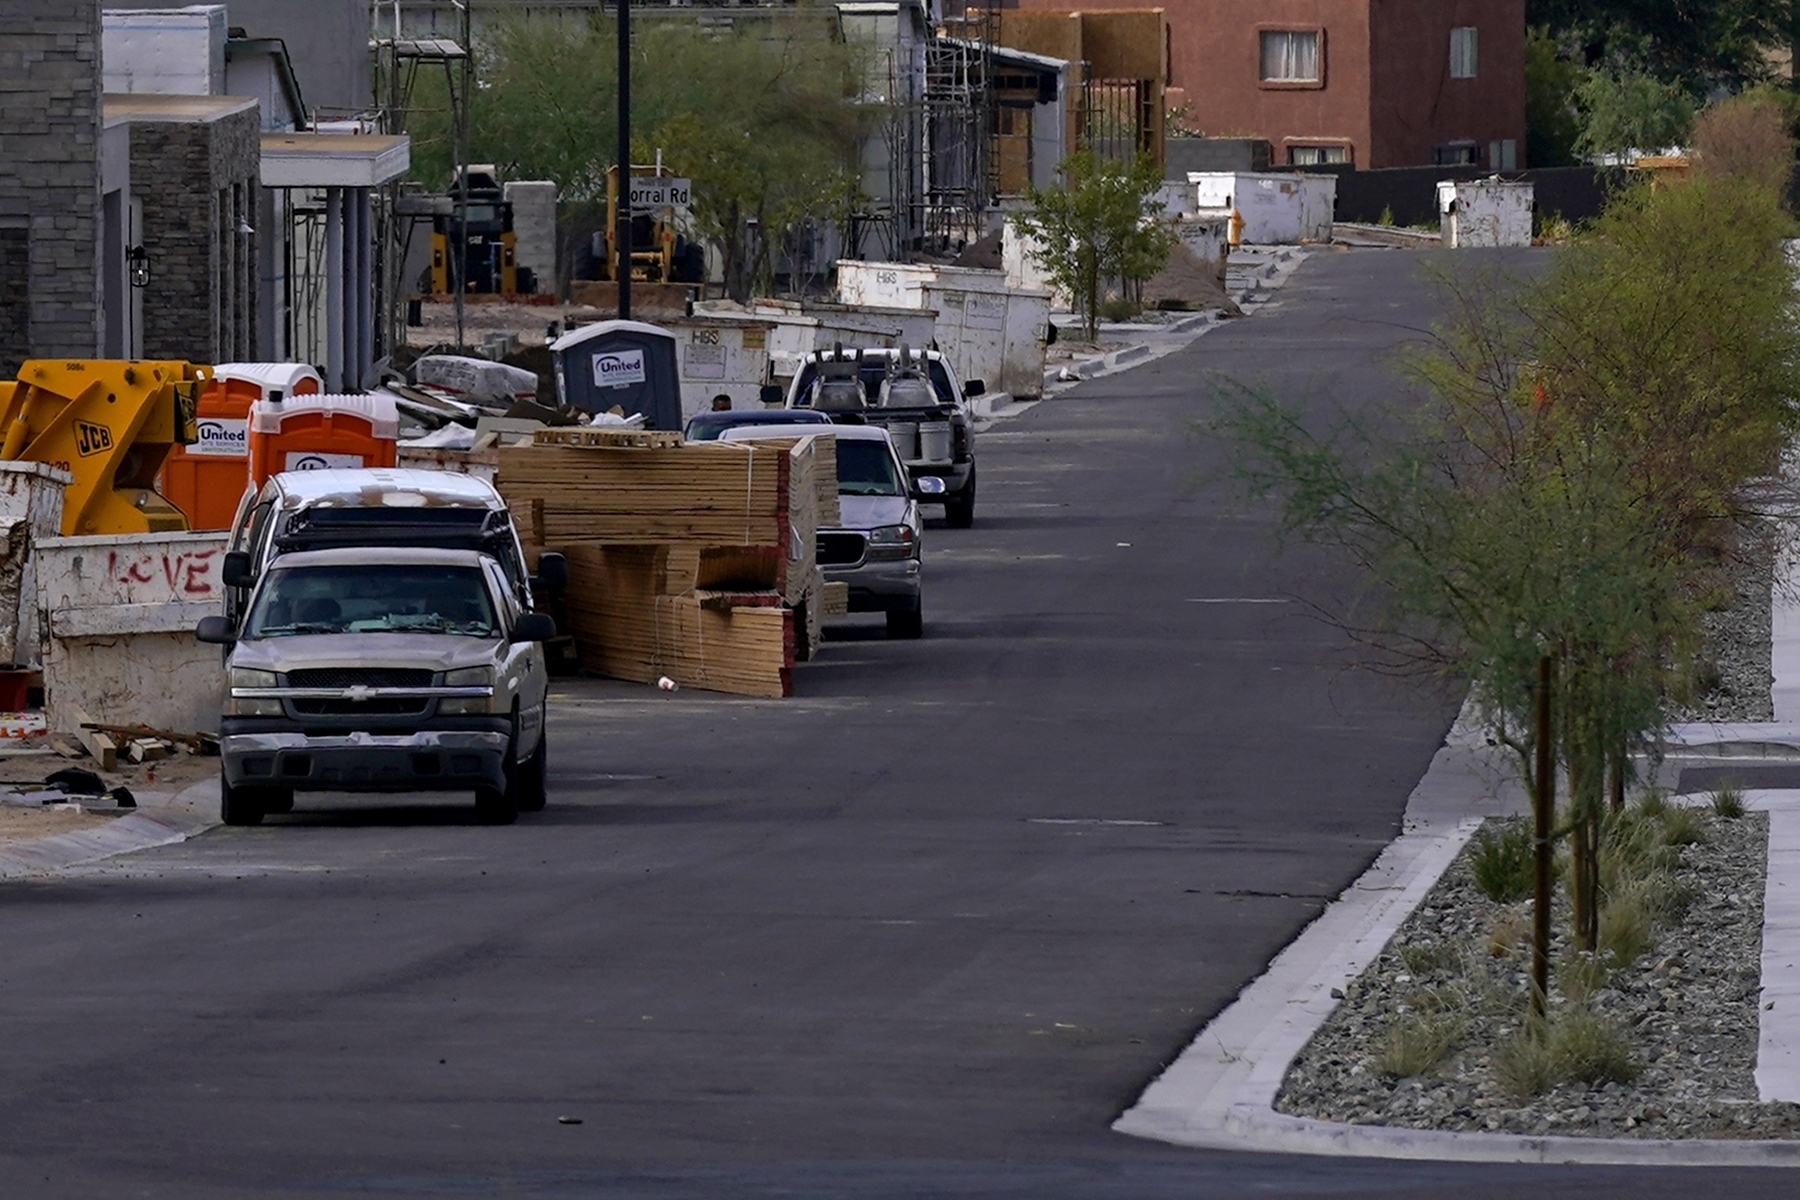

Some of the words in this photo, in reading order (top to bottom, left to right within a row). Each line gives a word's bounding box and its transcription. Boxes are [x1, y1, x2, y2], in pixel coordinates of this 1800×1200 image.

[630, 188, 665, 203] orral
[670, 187, 688, 204] Rd
[601, 358, 641, 373] United
[79, 423, 111, 454] JCB
[201, 428, 245, 441] United
